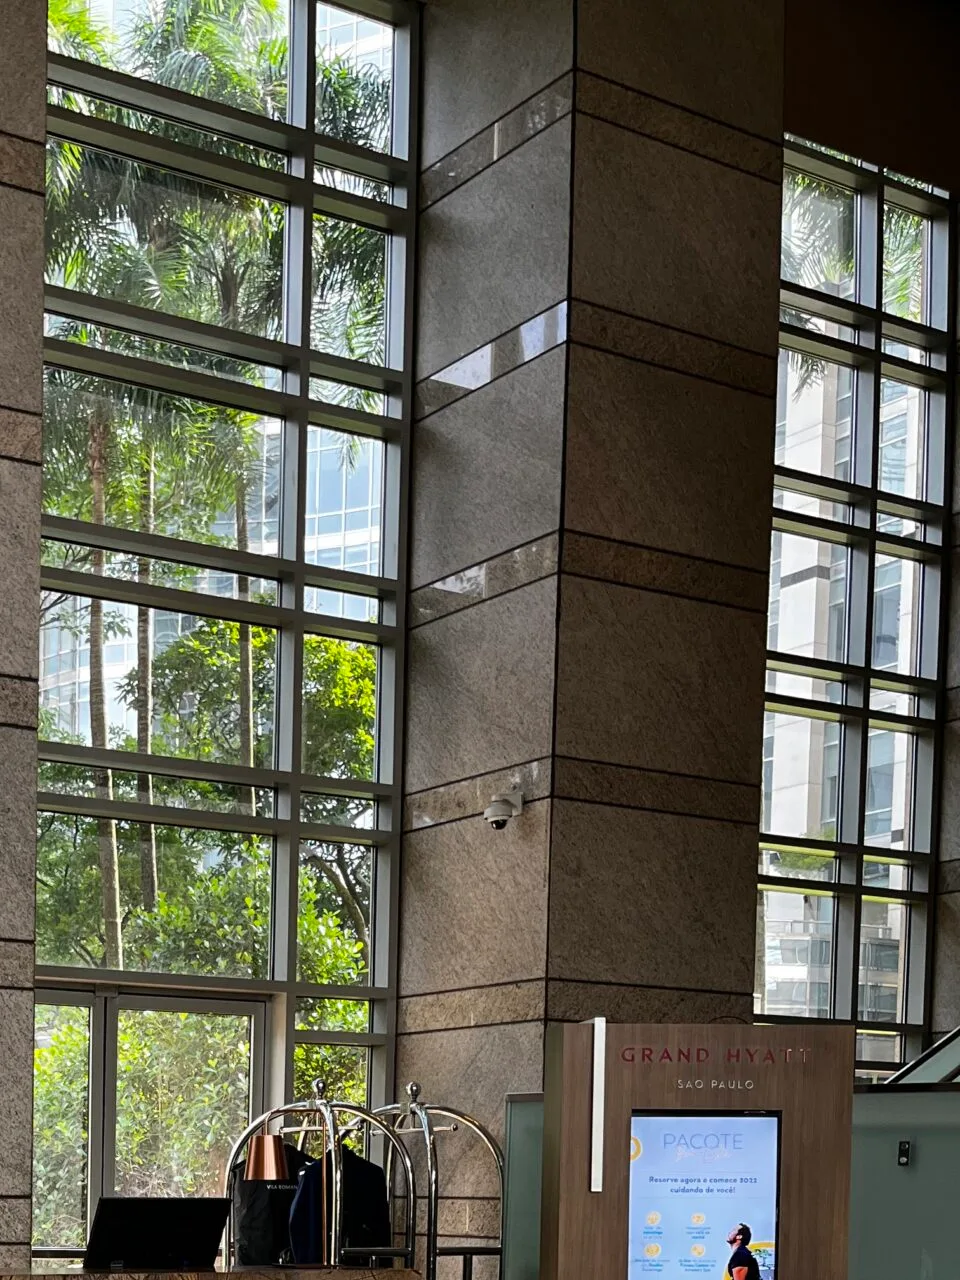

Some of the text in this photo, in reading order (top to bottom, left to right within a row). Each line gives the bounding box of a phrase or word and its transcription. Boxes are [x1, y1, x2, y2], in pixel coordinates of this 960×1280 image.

[621, 1047, 811, 1064] GRAND HYATT
[711, 1080, 754, 1089] PAULO
[663, 1133, 744, 1150] PACOTE
[648, 1176, 679, 1184] Reserve
[680, 1177, 701, 1185] agora
[670, 1186, 704, 1194] cuidando
[705, 1186, 715, 1194] de
